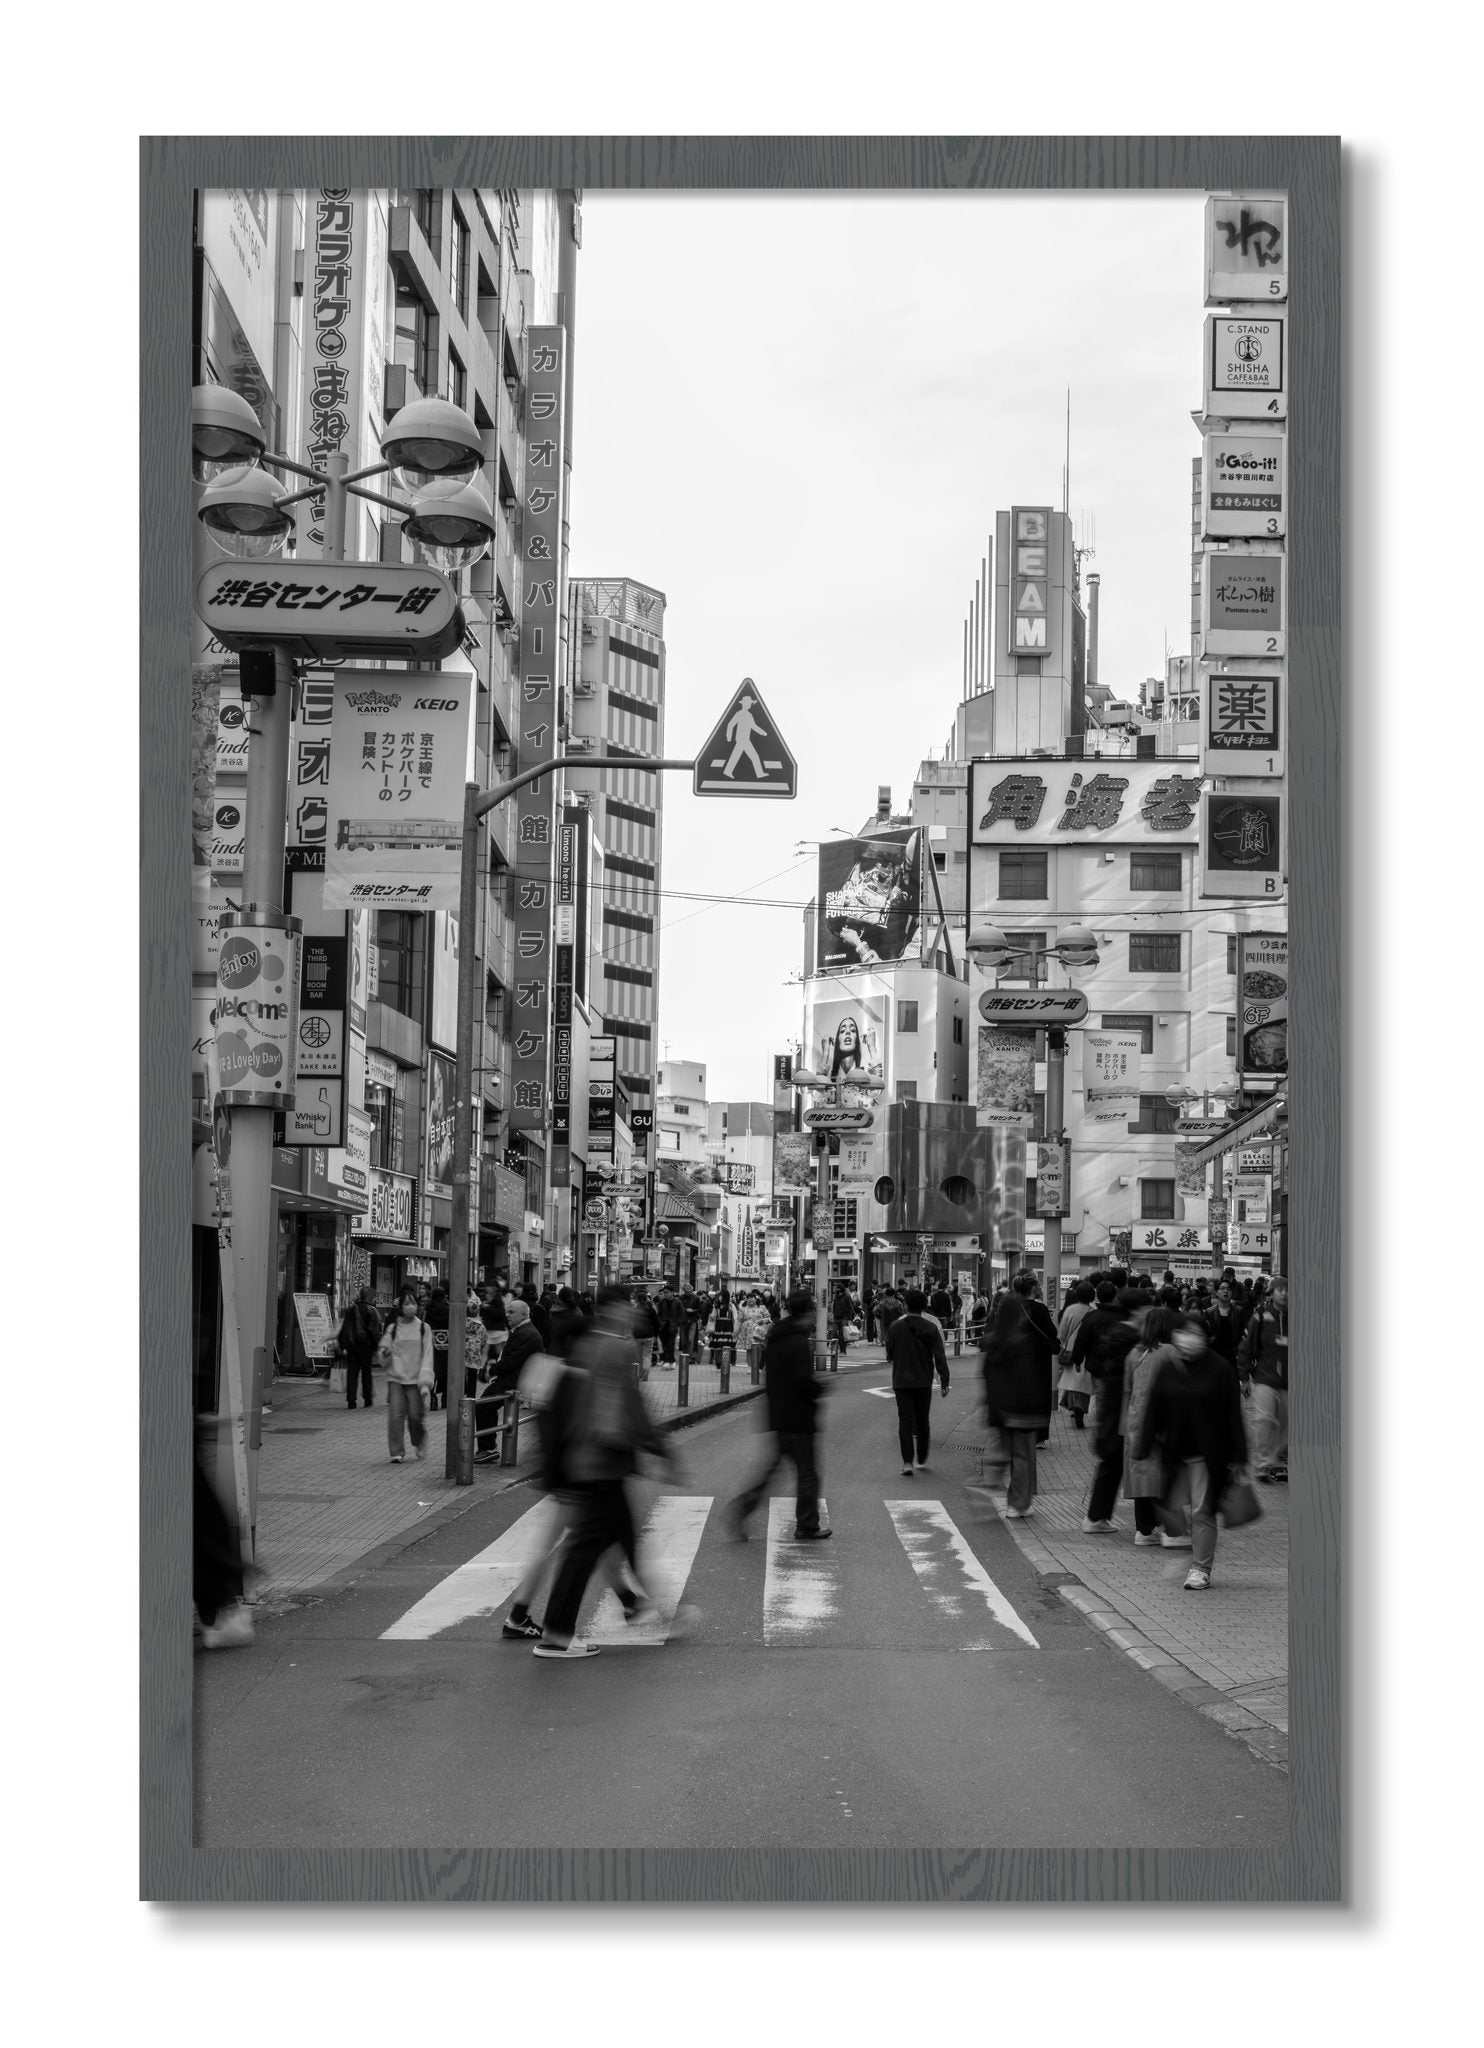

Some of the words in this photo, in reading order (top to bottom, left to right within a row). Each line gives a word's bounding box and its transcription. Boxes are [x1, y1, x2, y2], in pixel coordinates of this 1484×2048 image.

[314, 201, 353, 330] カラオケ
[1269, 281, 1280, 295] 5
[1227, 325, 1270, 334] C.STAND
[1227, 363, 1269, 373] SHISHA
[1227, 373, 1269, 382] CAFE&BAR
[1268, 399, 1280, 414] 4
[1226, 455, 1277, 469] Goo-it!
[1215, 497, 1278, 508] 全身もみほぐし
[1267, 518, 1278, 533] 3
[1016, 511, 1047, 647] BEAM
[208, 579, 441, 614] 渋谷センター街
[1216, 585, 1275, 603] ポムの樹
[1266, 637, 1278, 652] 2
[414, 699, 459, 711] KEIO
[1219, 683, 1266, 730] 薬
[1213, 734, 1271, 746] マツモトキヨシ
[361, 731, 377, 772] 冒険へ
[220, 758, 243, 766] 渋谷店
[379, 732, 396, 801] カントーの
[418, 733, 434, 789] 京王線で
[1266, 757, 1274, 772] 1
[979, 773, 1201, 831] 角海老
[562, 829, 571, 862] kimono
[217, 858, 240, 867] 渋谷店
[349, 884, 433, 896] 渋谷センター街
[562, 867, 571, 899] hearts
[1265, 878, 1276, 892] B
[826, 889, 863, 902] SHAPING
[1245, 952, 1286, 964] 四川料理
[220, 950, 258, 982] Enjoy
[216, 996, 288, 1020] Welcome
[986, 998, 1081, 1010] 渋谷センター街
[1243, 1006, 1271, 1024] 6F
[232, 1051, 260, 1071] Lovely
[263, 1053, 281, 1064] Day!
[296, 1112, 326, 1123] Whisky
[633, 1116, 652, 1126] GU
